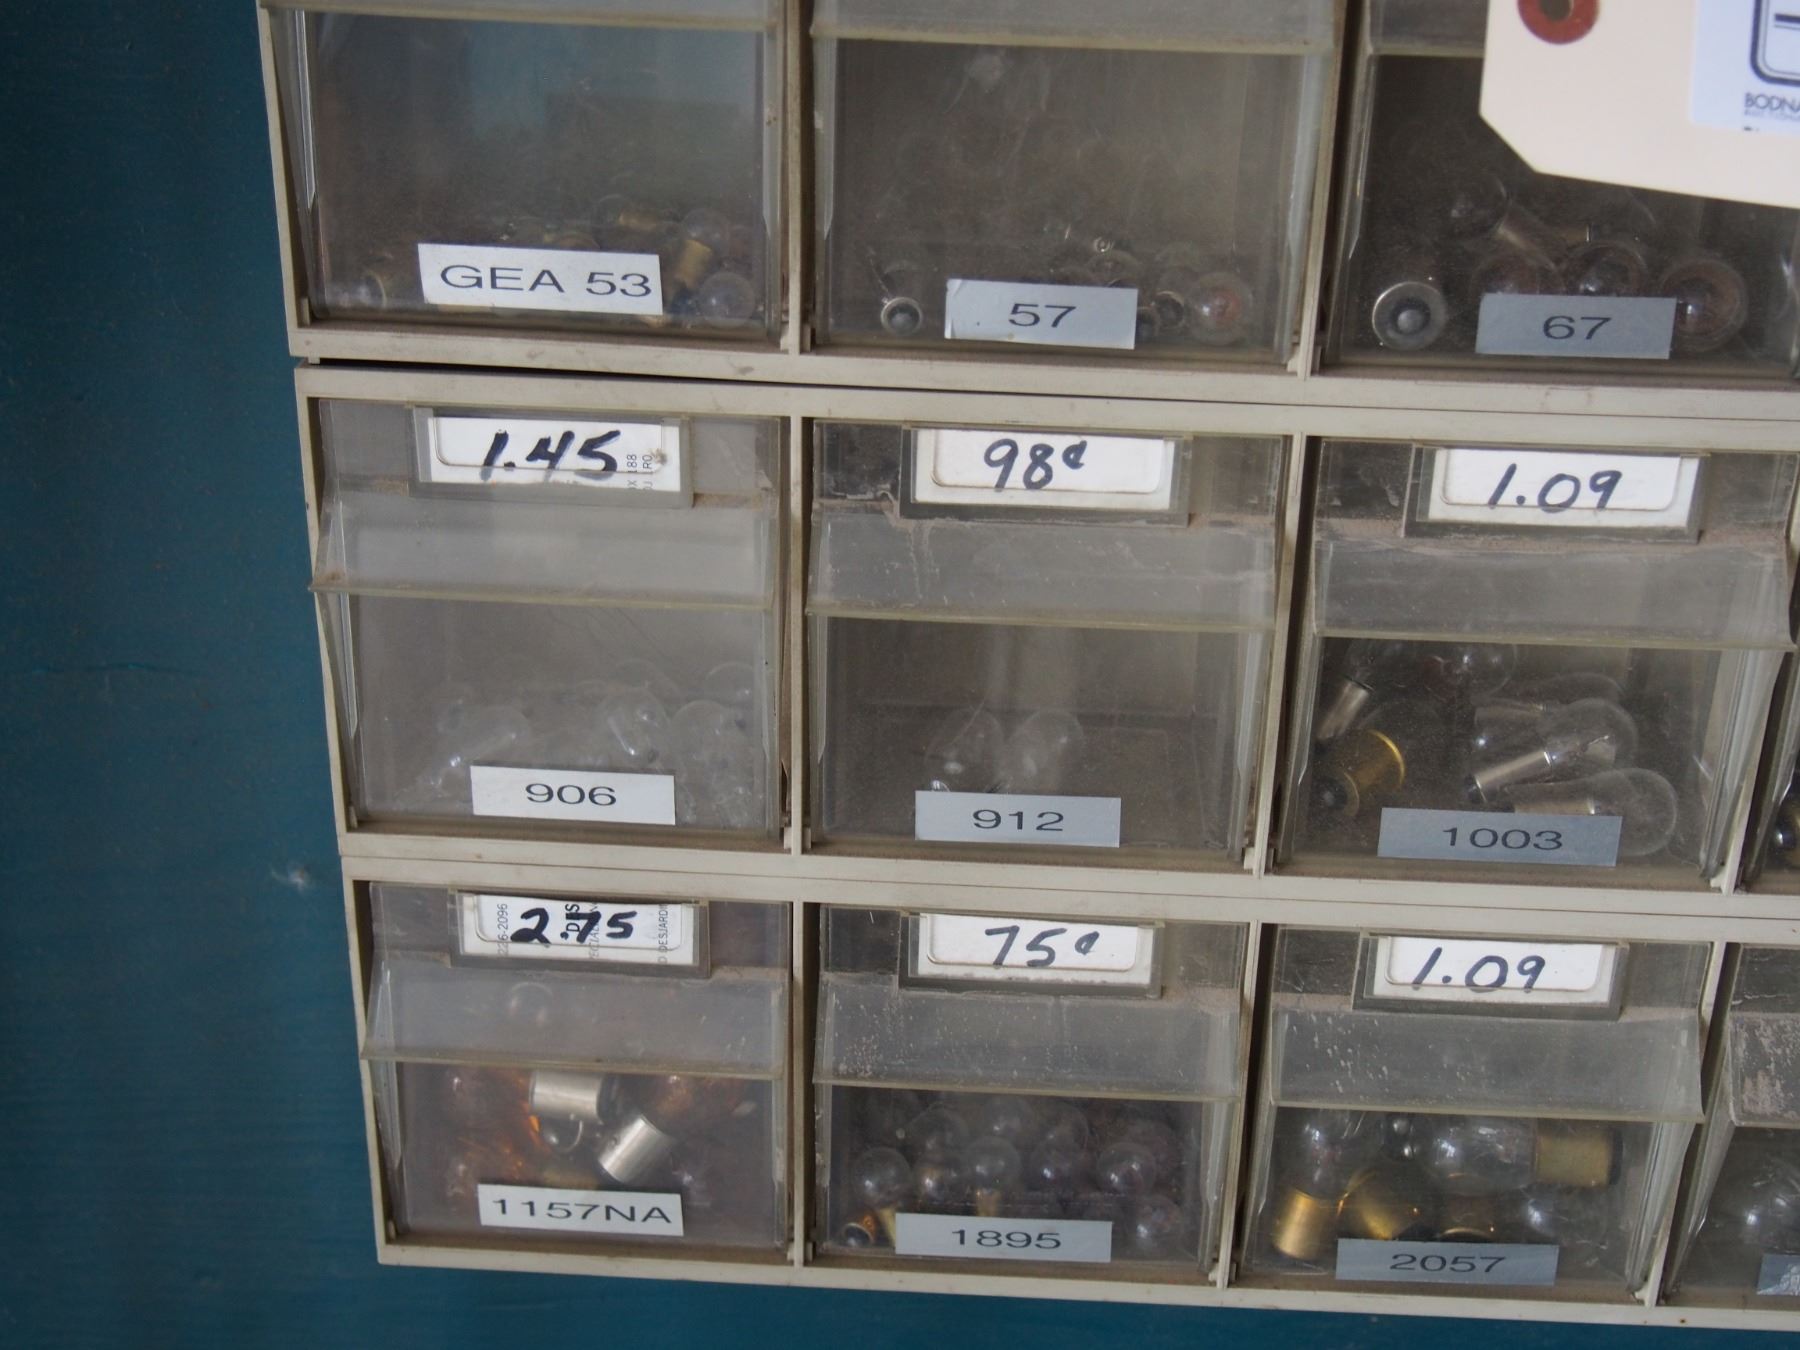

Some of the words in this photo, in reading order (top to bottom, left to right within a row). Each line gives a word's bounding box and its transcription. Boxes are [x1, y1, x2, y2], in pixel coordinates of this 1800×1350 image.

[440, 264, 565, 293] GEA
[586, 272, 652, 297] 53
[1008, 303, 1077, 328] 57
[1543, 315, 1612, 340] 67
[480, 429, 621, 481] 1.45
[1488, 463, 1622, 514] 1.09
[525, 783, 617, 806] 906
[973, 809, 1064, 831] 912
[1443, 827, 1562, 850] 1003
[510, 907, 638, 949] 2.75
[1411, 947, 1546, 993] 1.09
[493, 1199, 672, 1224] 1157NA
[951, 1229, 1061, 1249] 1895
[1390, 1253, 1506, 1273] 2057
